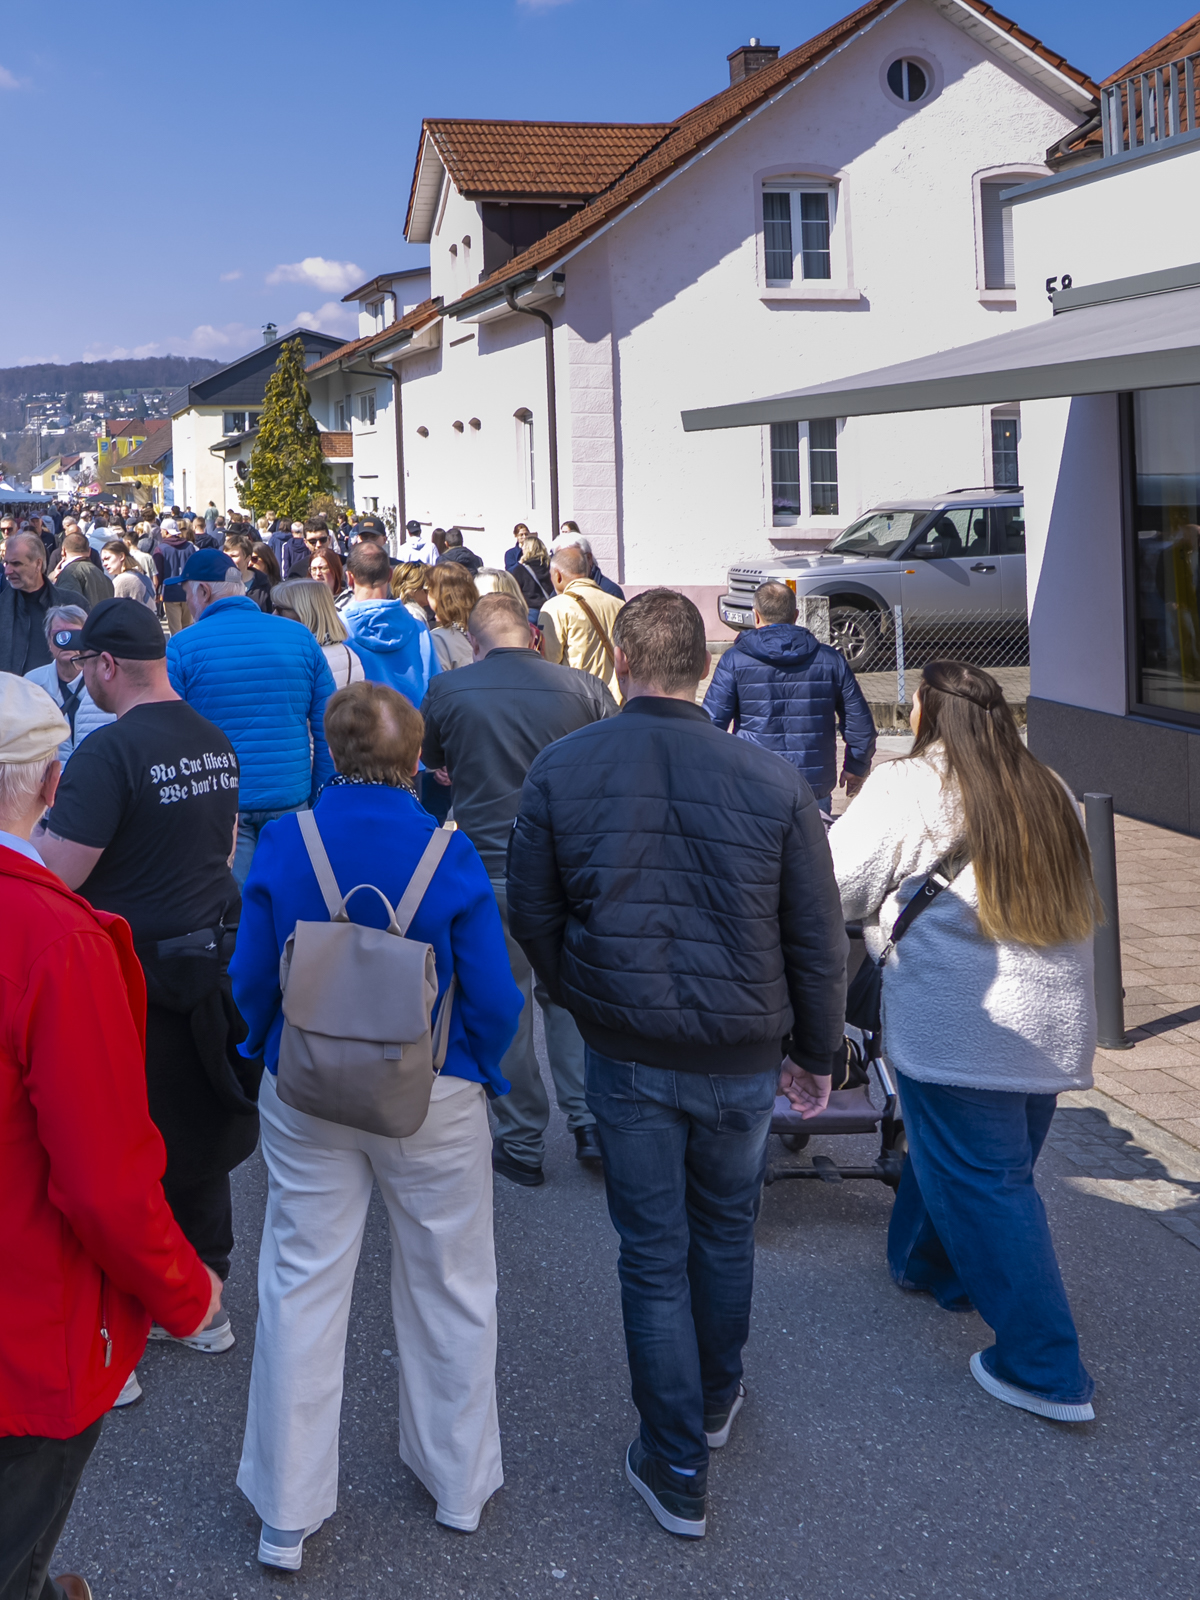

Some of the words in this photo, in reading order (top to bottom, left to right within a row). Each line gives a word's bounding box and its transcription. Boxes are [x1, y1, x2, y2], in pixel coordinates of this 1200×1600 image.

[150, 763, 177, 784] No
[180, 757, 202, 776] One
[202, 752, 229, 770] likes
[159, 783, 189, 805] We
[191, 775, 218, 796] don't
[220, 772, 239, 789] Car
